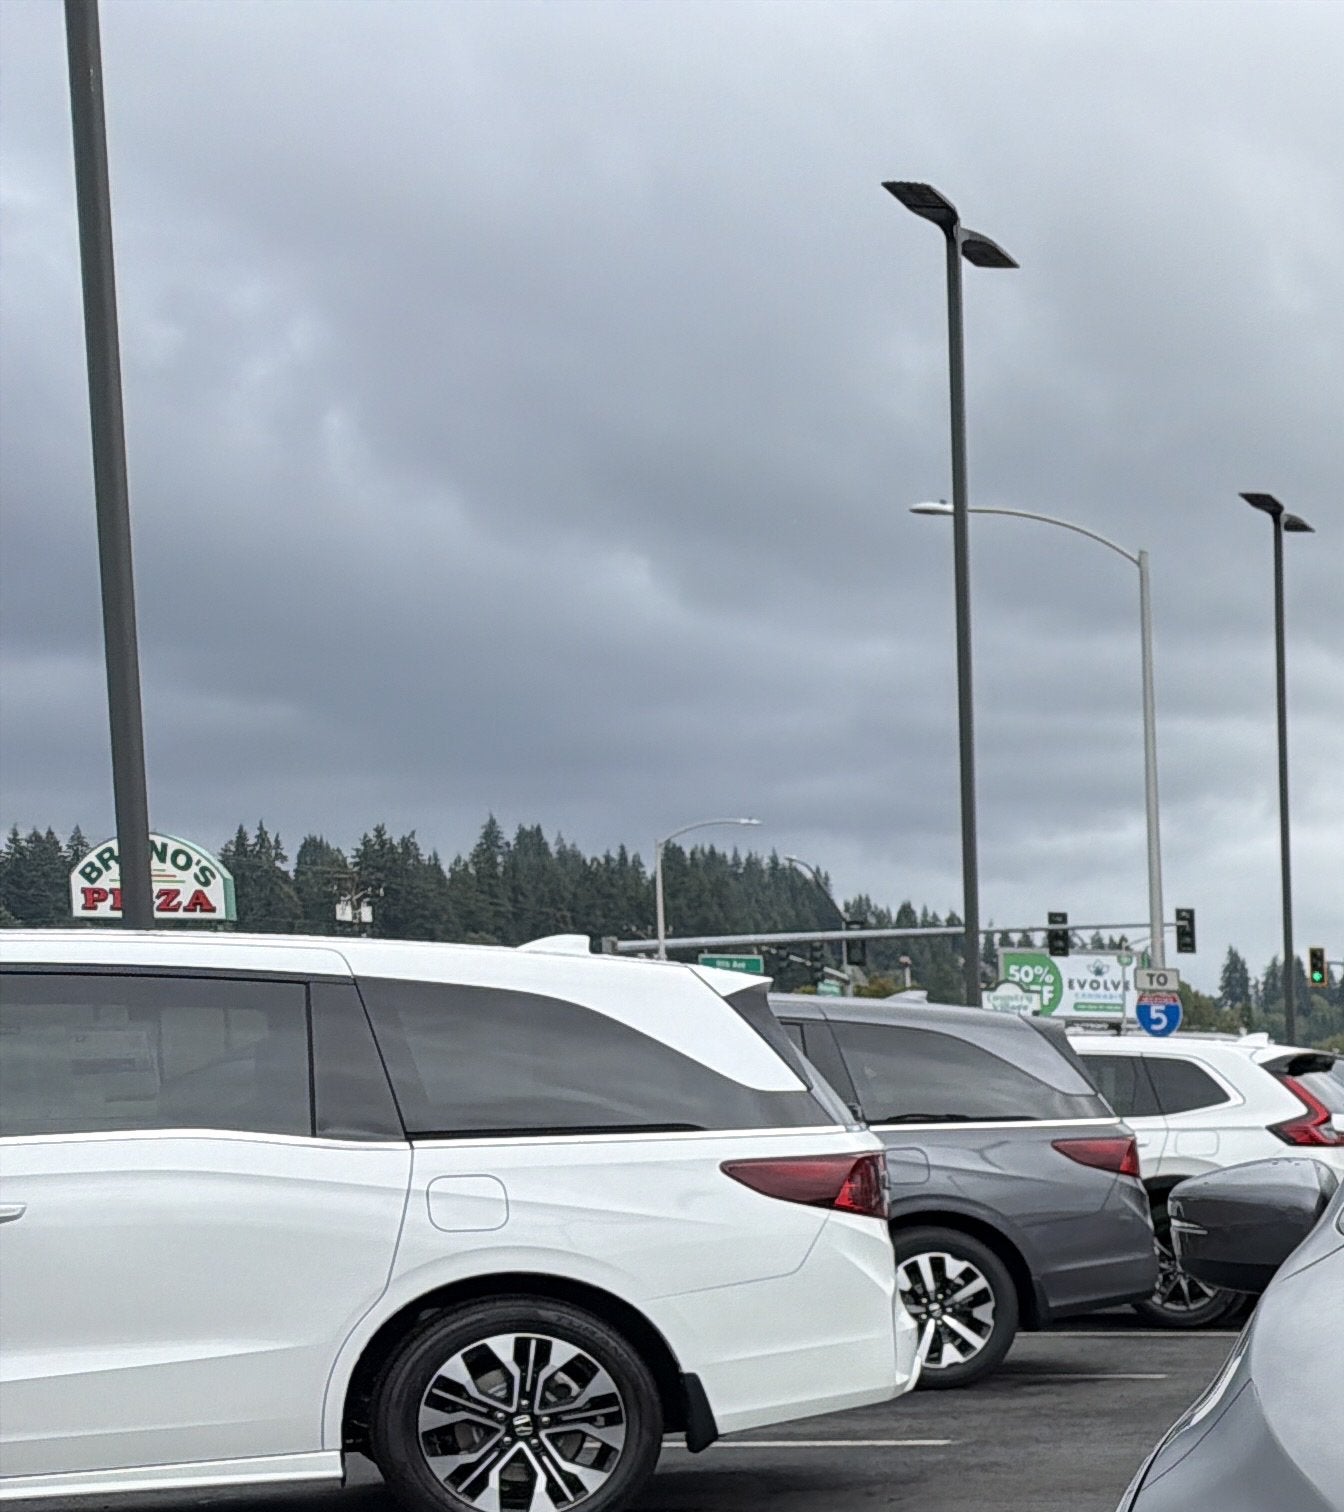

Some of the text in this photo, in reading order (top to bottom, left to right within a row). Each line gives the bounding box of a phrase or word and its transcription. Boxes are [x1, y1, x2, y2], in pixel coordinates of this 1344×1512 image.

[78, 840, 217, 888] BRNO'S
[81, 887, 217, 913] PIZA
[1008, 965, 1054, 983] 50%
[1146, 973, 1168, 986] TO
[1068, 979, 1131, 992] EVOLVE
[1150, 1005, 1168, 1031] 5
